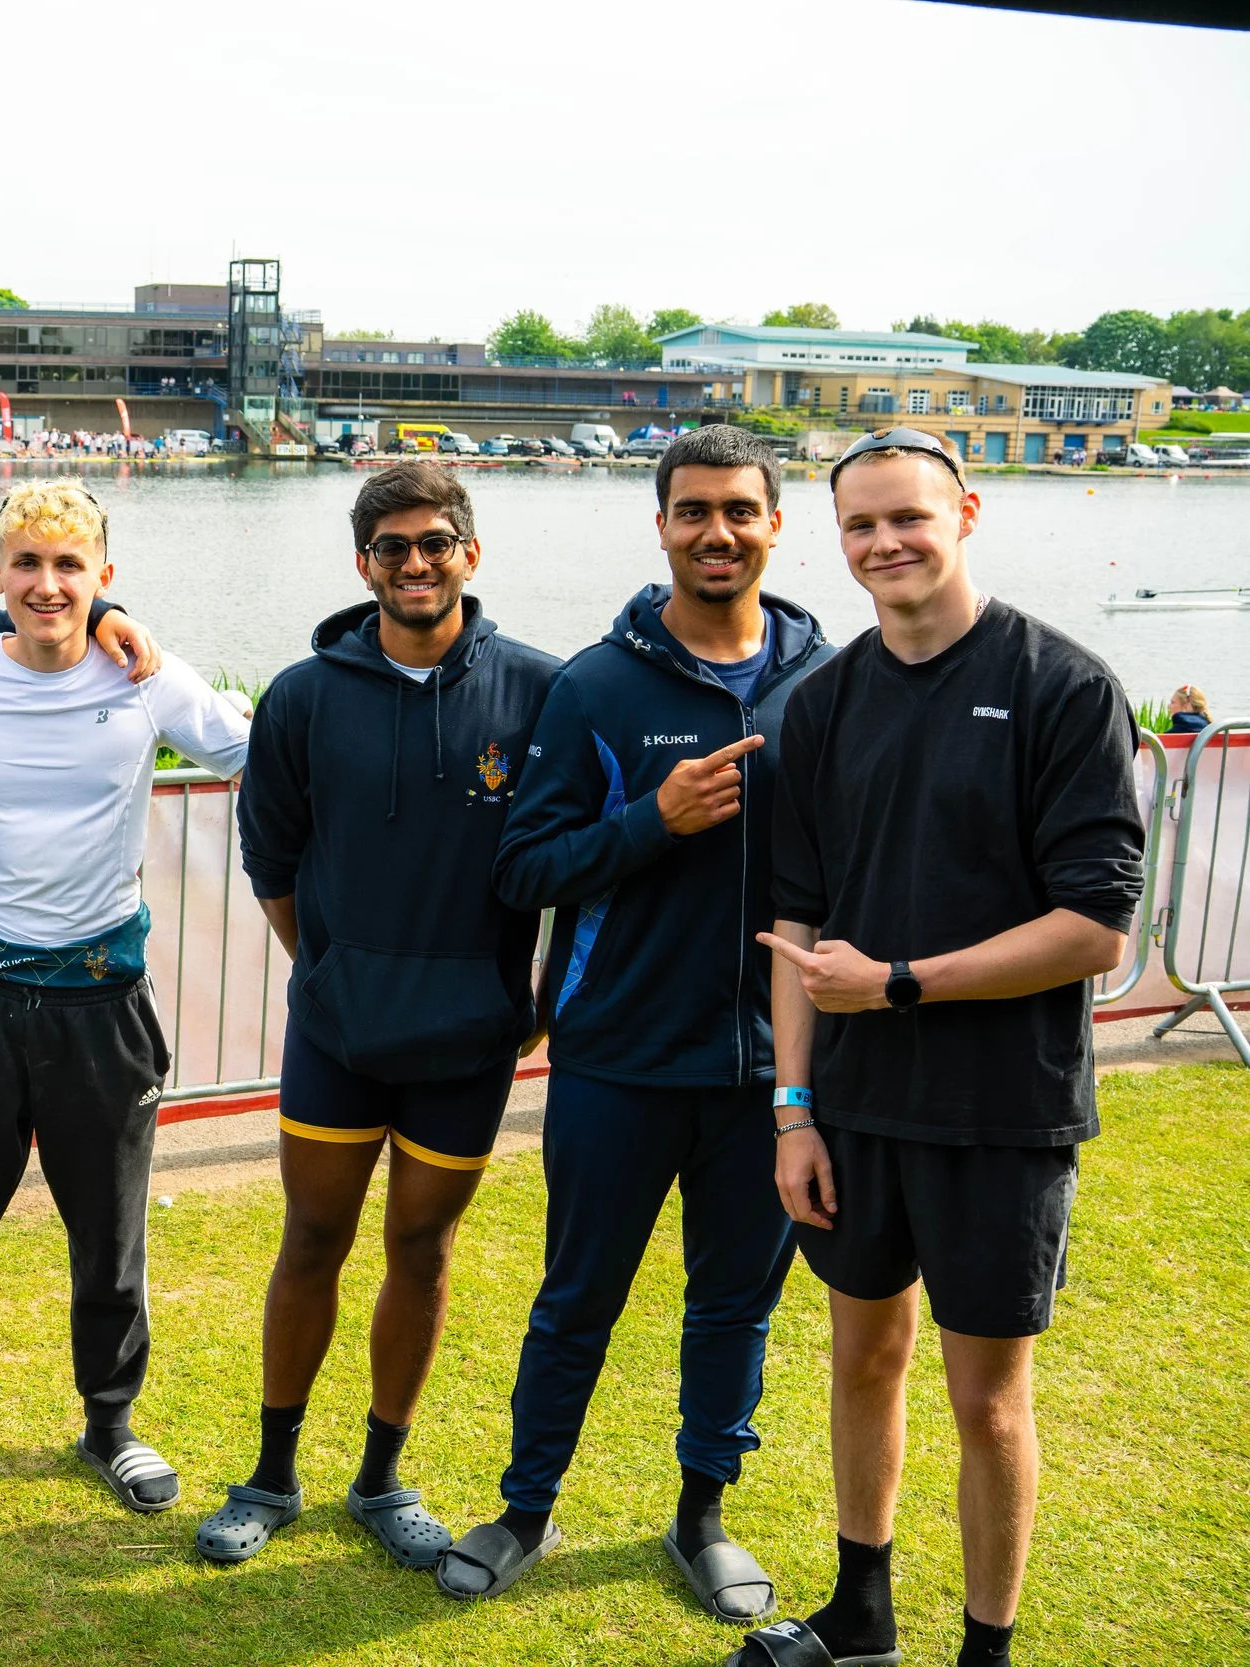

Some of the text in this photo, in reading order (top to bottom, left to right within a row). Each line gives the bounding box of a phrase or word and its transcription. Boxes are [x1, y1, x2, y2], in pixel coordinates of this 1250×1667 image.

[973, 706, 1009, 719] GYMSHARK
[654, 735, 698, 744] KUKRI
[139, 1091, 161, 1106] adidas
